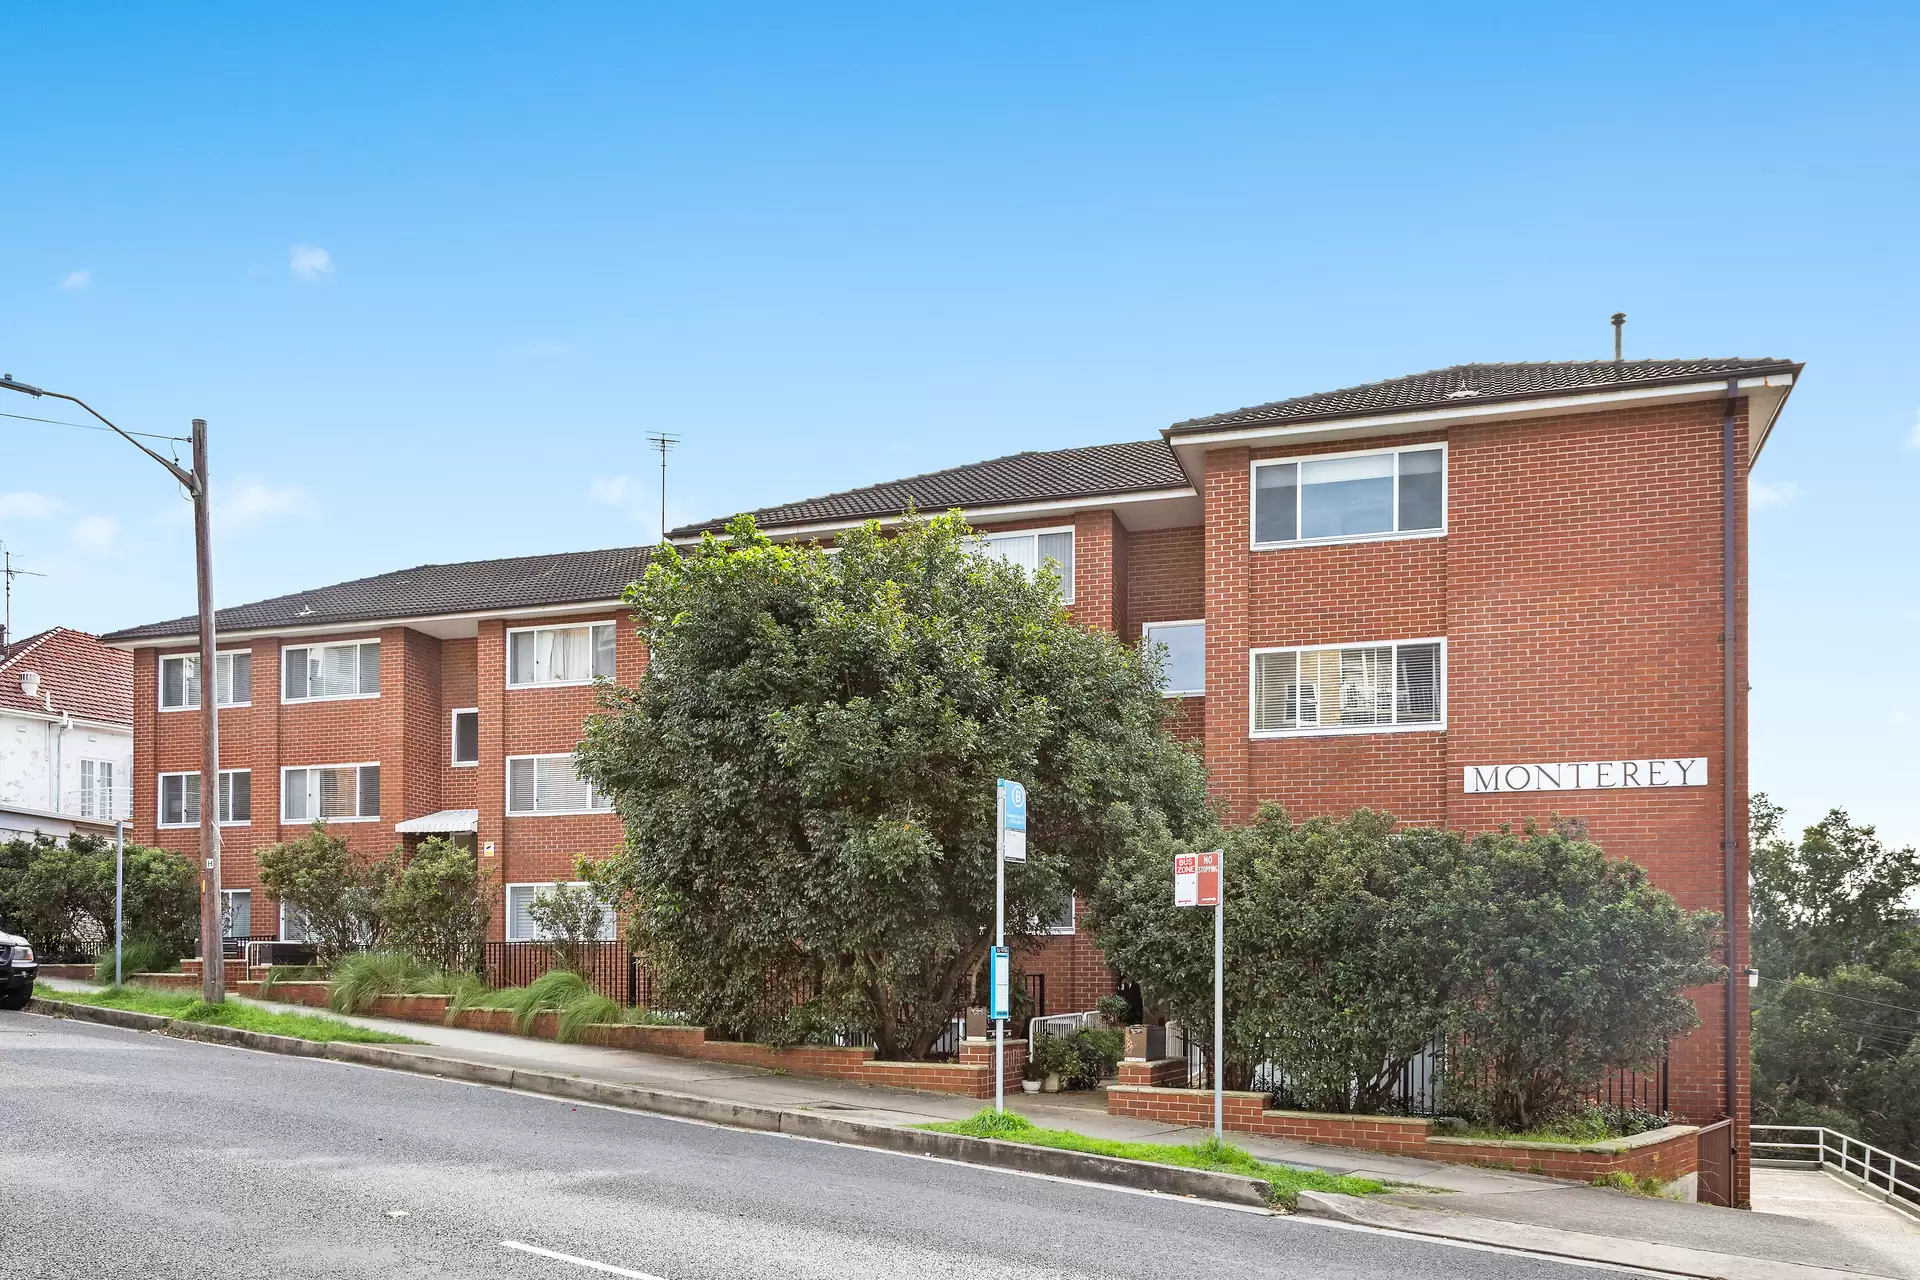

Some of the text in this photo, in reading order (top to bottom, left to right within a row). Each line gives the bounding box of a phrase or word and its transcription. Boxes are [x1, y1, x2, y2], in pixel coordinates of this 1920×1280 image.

[1473, 759, 1697, 791] MONTEREY
[1179, 858, 1193, 866] BUS
[1204, 856, 1212, 864] NO
